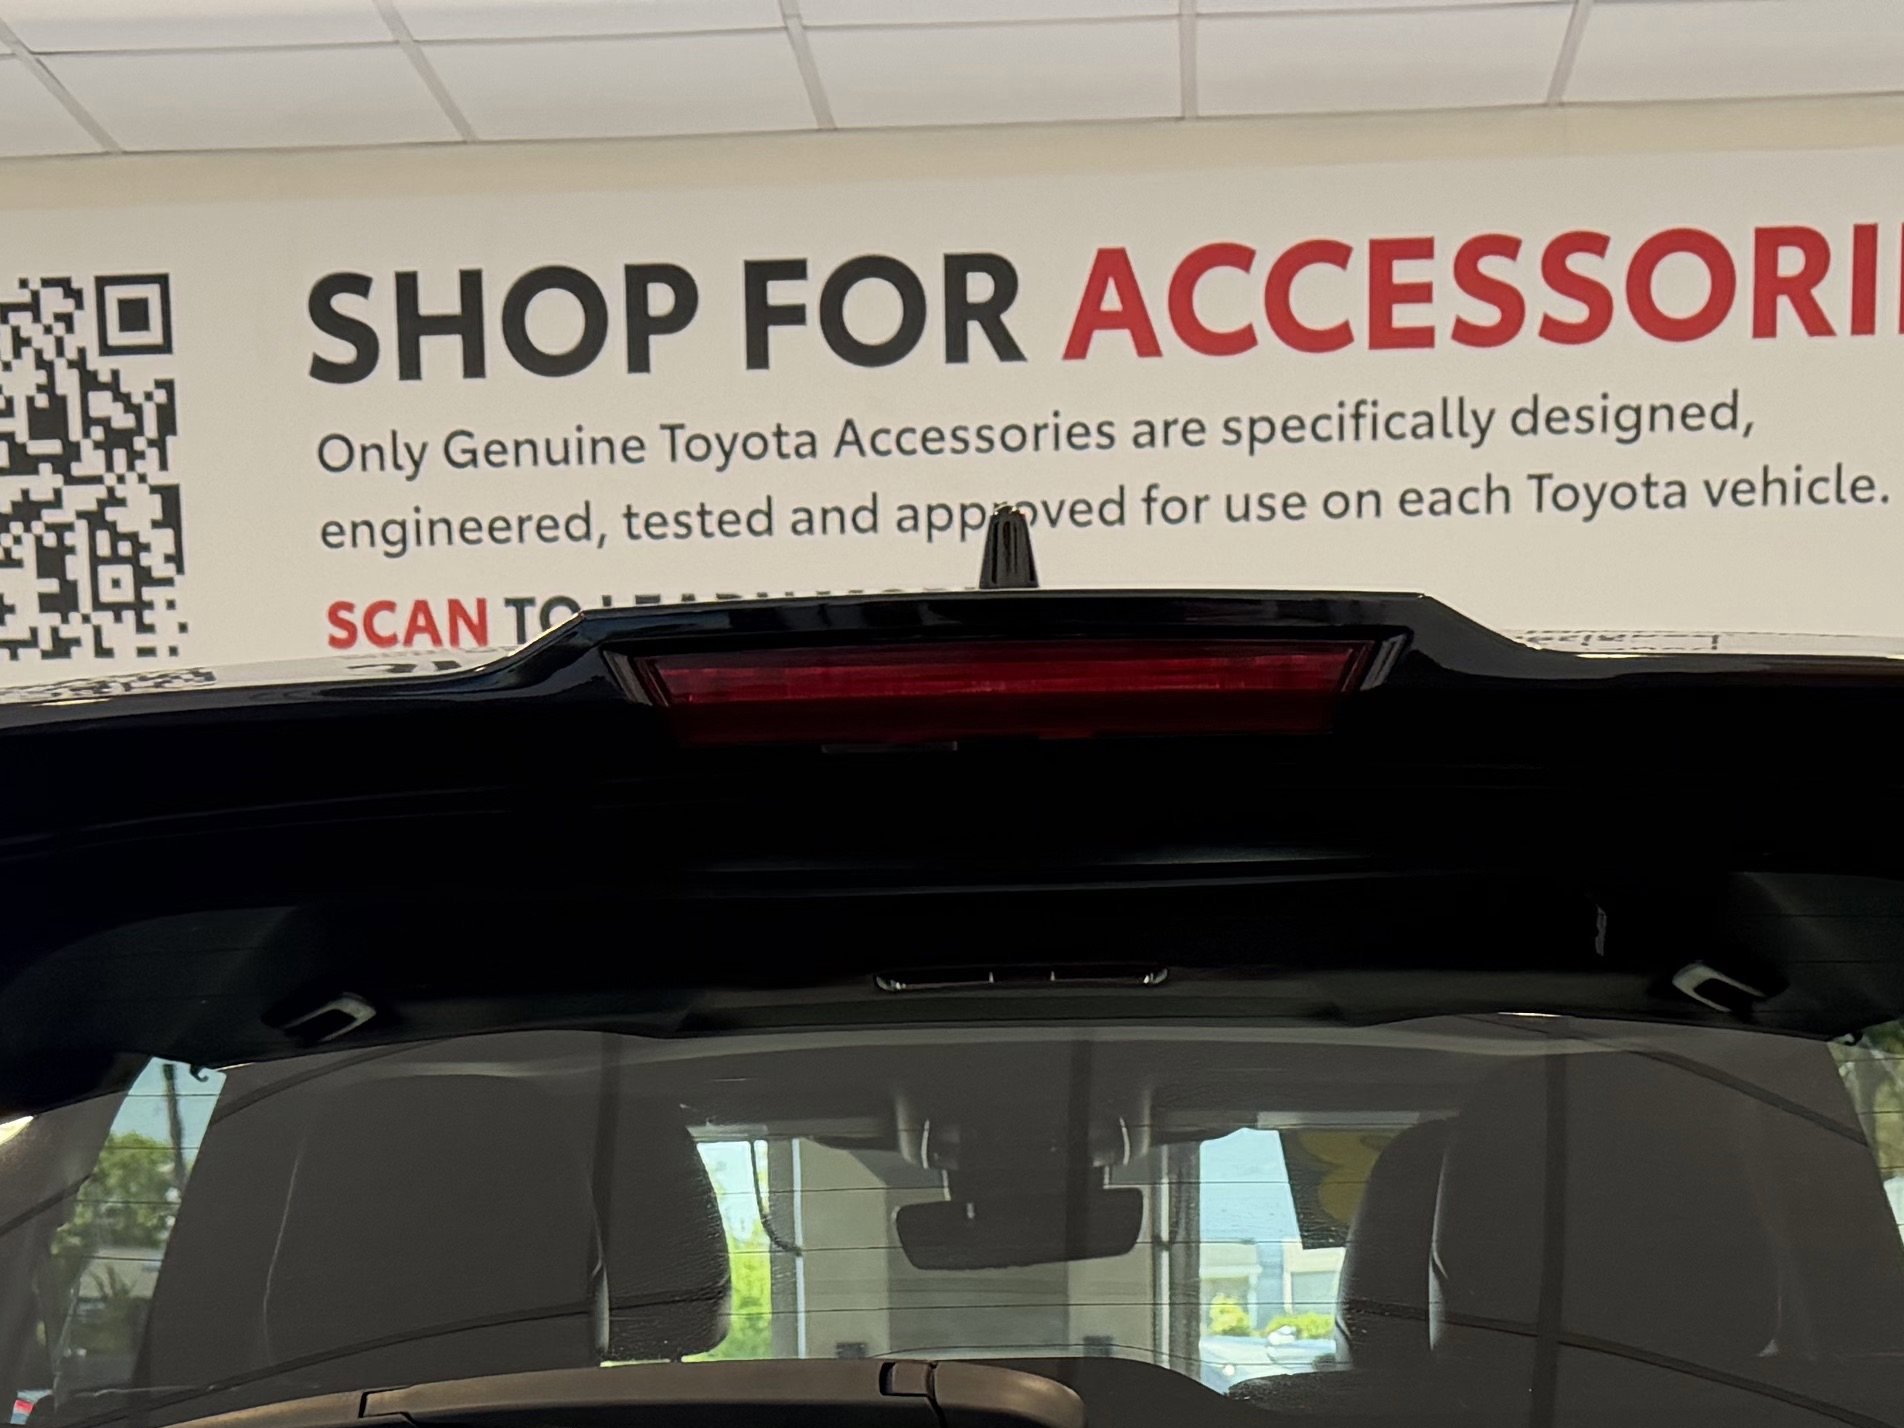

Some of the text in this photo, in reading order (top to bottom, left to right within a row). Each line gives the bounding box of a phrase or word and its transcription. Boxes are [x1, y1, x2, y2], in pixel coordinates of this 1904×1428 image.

[306, 262, 699, 386] SHOP
[743, 252, 1027, 371] FOR
[316, 388, 1757, 482] Only Genuine Toyota Accessories are specifically designed,
[319, 463, 1892, 560] engineered, tested and appoved for use on each Toyota vehicle.
[326, 597, 489, 651] SCAN
